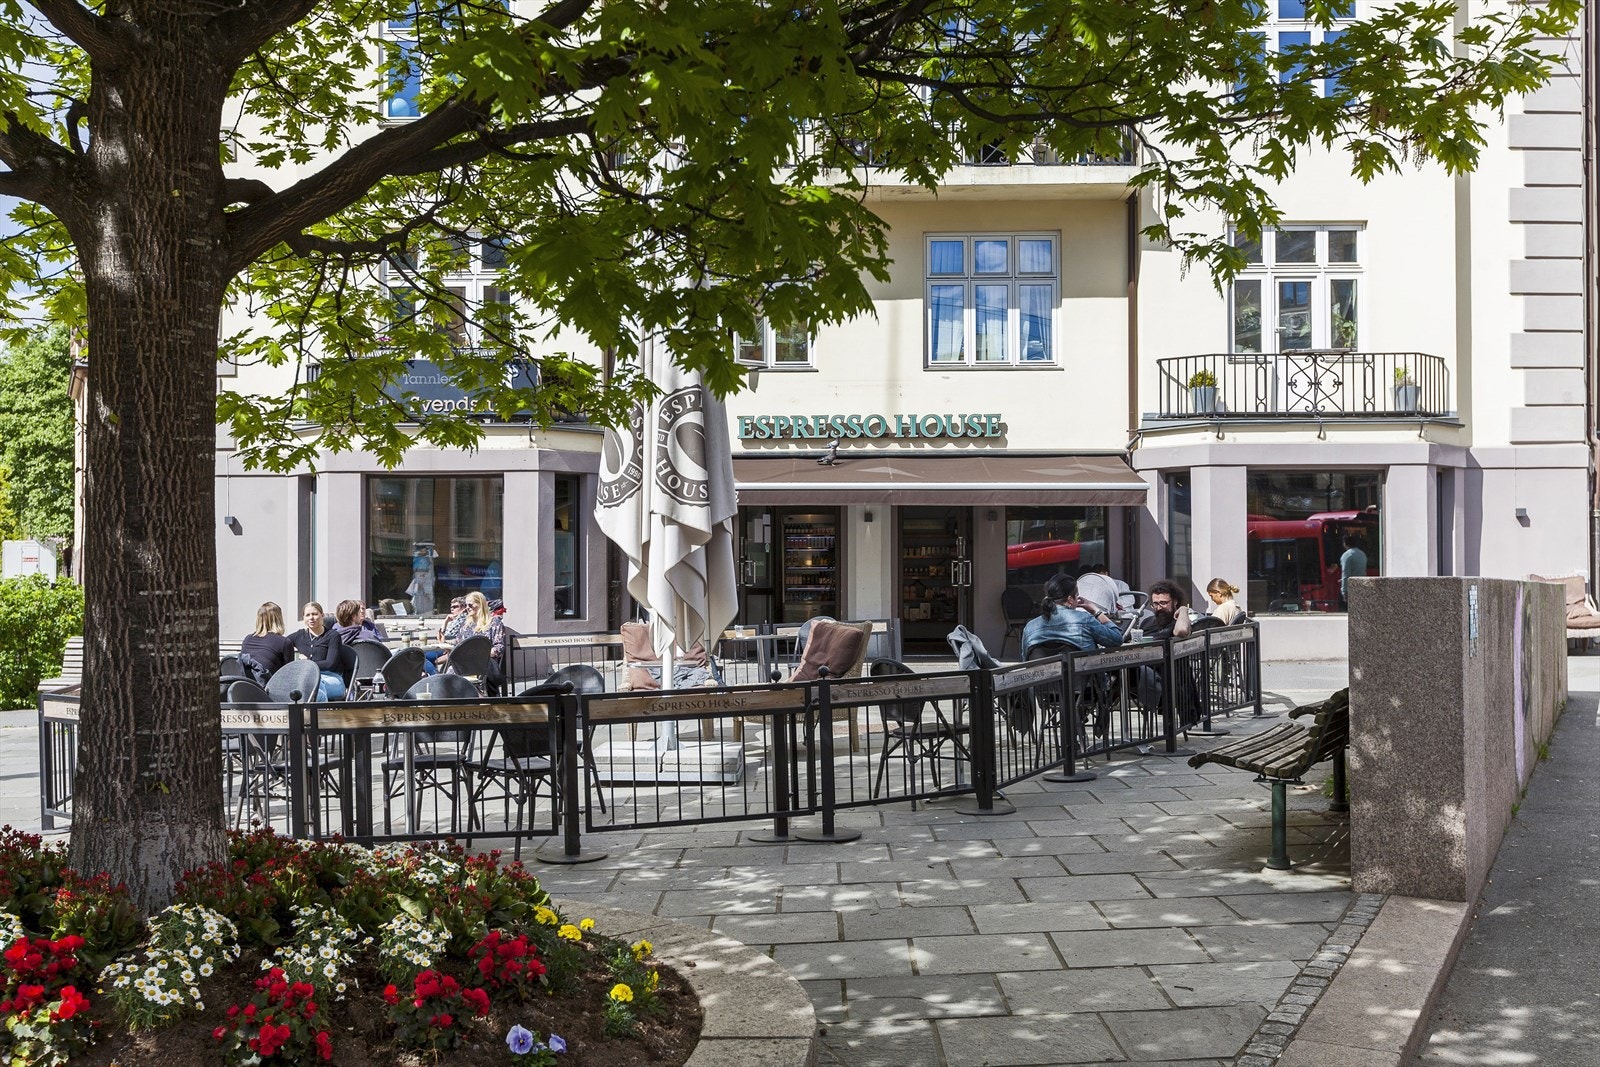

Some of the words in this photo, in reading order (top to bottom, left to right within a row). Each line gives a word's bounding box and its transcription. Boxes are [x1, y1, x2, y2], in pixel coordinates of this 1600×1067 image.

[737, 414, 887, 440] ESPRESSO
[894, 413, 1002, 438] HOUSE
[656, 458, 709, 499] HOUS
[847, 687, 891, 698] ESPRESSO
[652, 699, 706, 712] ESPRESSO
[709, 697, 748, 709] HOUSE
[221, 714, 251, 724] RESSO
[253, 714, 288, 724] HOUSE
[383, 712, 441, 723] ESPRESSO
